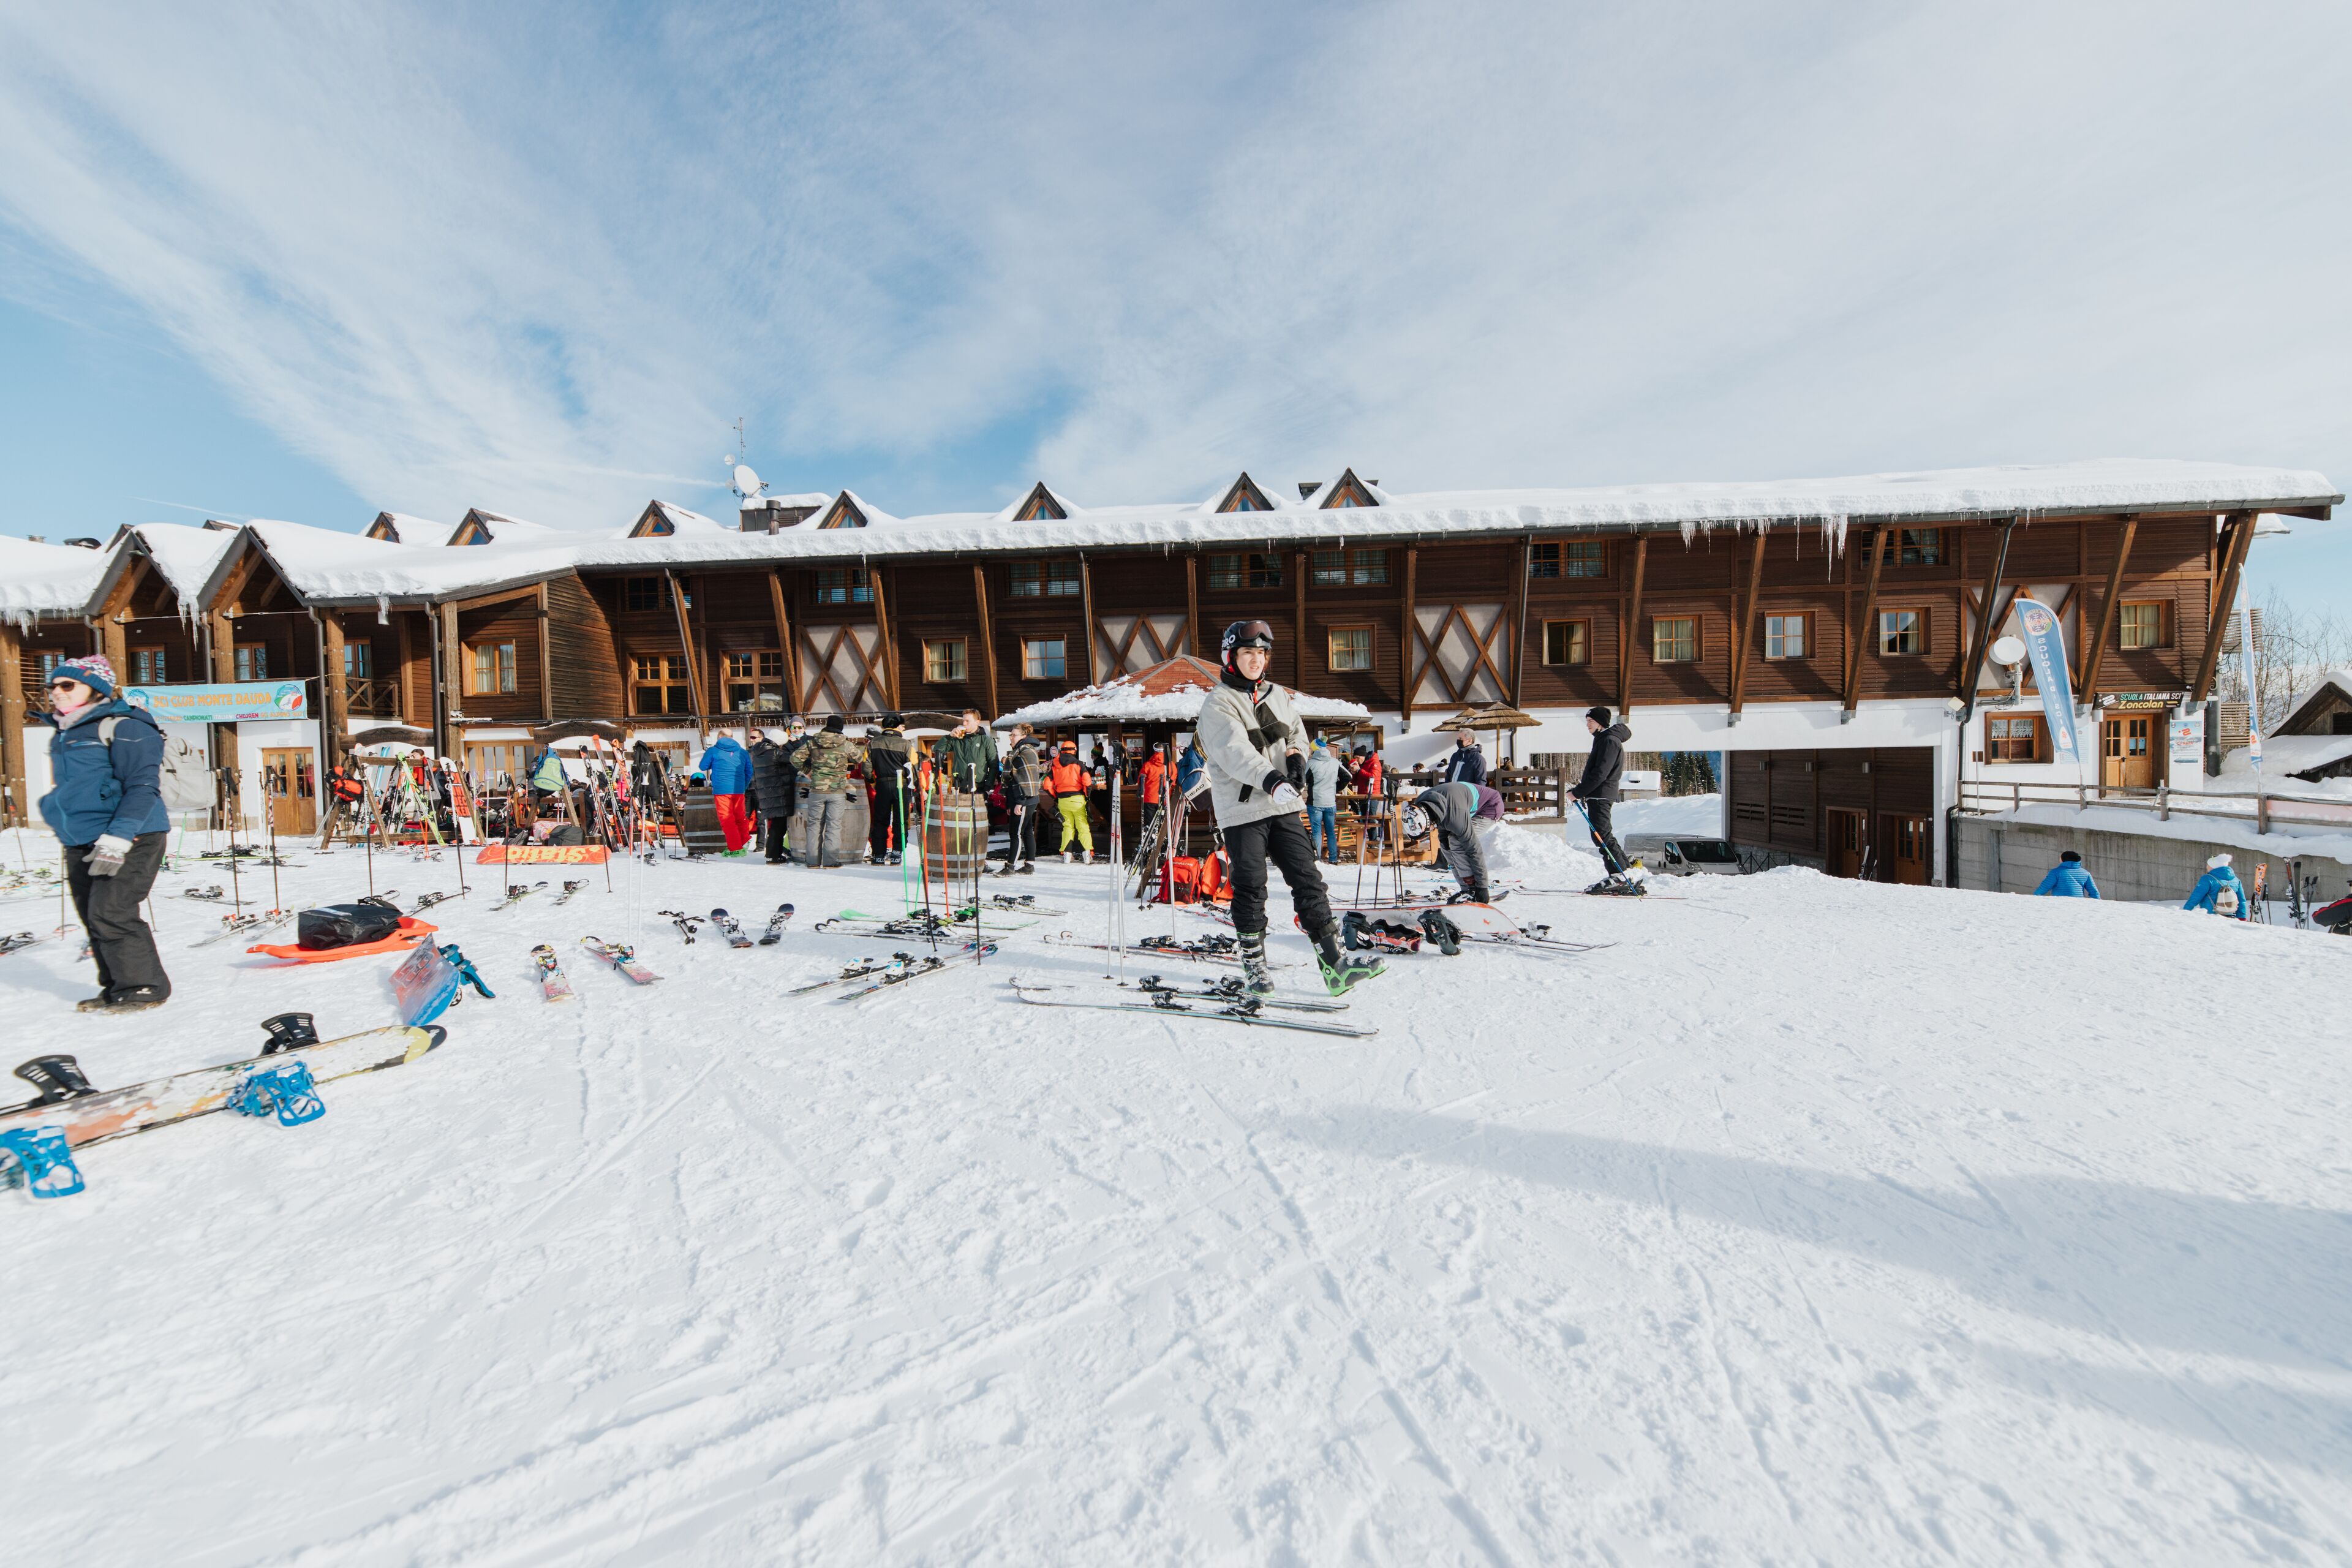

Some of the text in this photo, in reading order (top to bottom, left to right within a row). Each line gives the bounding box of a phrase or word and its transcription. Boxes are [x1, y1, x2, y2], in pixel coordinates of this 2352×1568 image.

[154, 695, 168, 707] SCI
[170, 695, 194, 707] CLUB
[197, 694, 233, 706] MONTE
[235, 692, 271, 704] DAUDA
[2118, 700, 2164, 709] Zoncolan
[1186, 783, 1205, 798] HEAD
